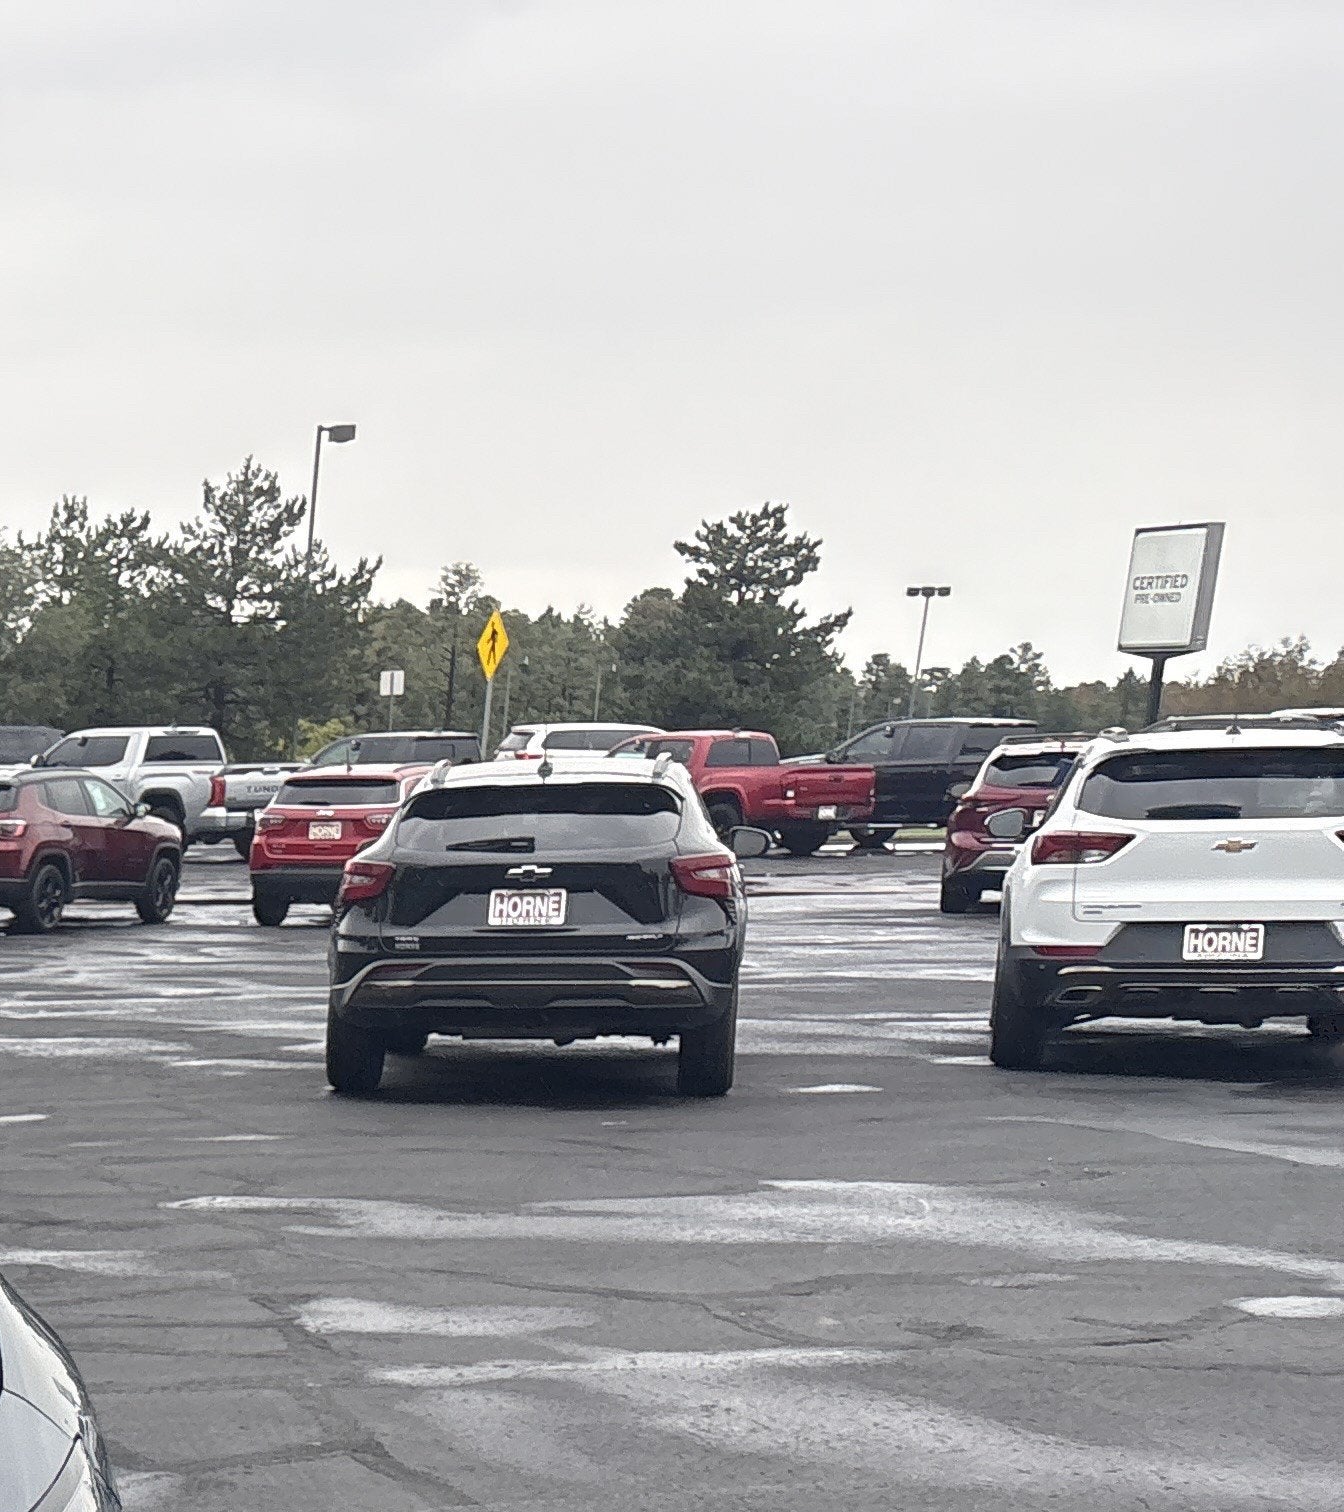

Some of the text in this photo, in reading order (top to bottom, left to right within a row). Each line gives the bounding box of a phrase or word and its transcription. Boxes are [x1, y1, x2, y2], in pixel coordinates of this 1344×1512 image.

[1132, 573, 1189, 591] CERTIFIED
[493, 894, 562, 919] HORNE
[1188, 930, 1259, 953] HORNE
